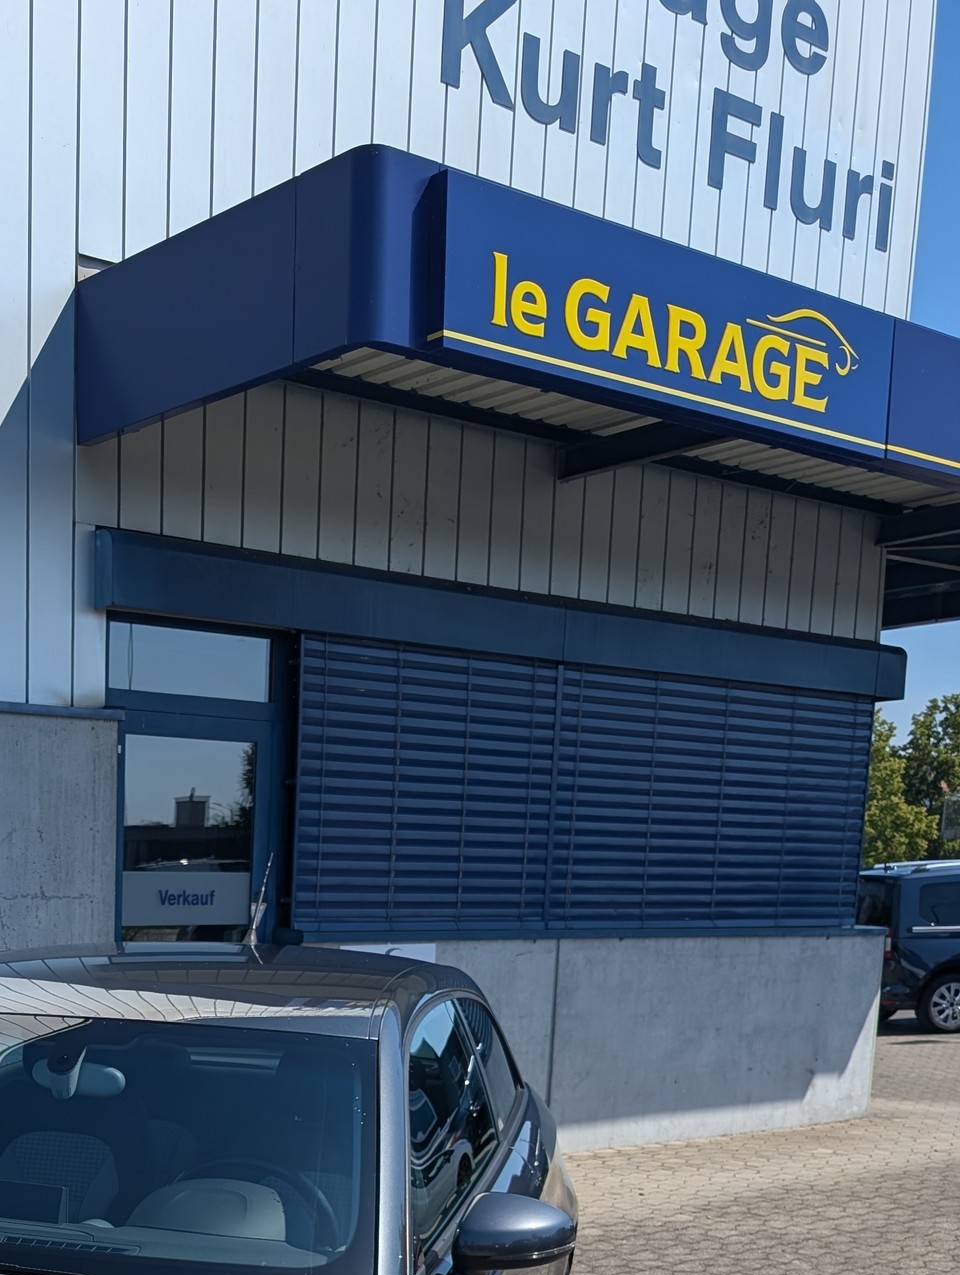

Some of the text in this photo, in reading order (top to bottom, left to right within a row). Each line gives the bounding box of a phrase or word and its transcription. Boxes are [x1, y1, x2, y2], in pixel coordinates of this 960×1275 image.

[658, 0, 830, 75] ge
[440, 0, 895, 253] Kurt Fluri
[491, 251, 829, 413] le GARAGE
[158, 889, 216, 907] Verkauf
